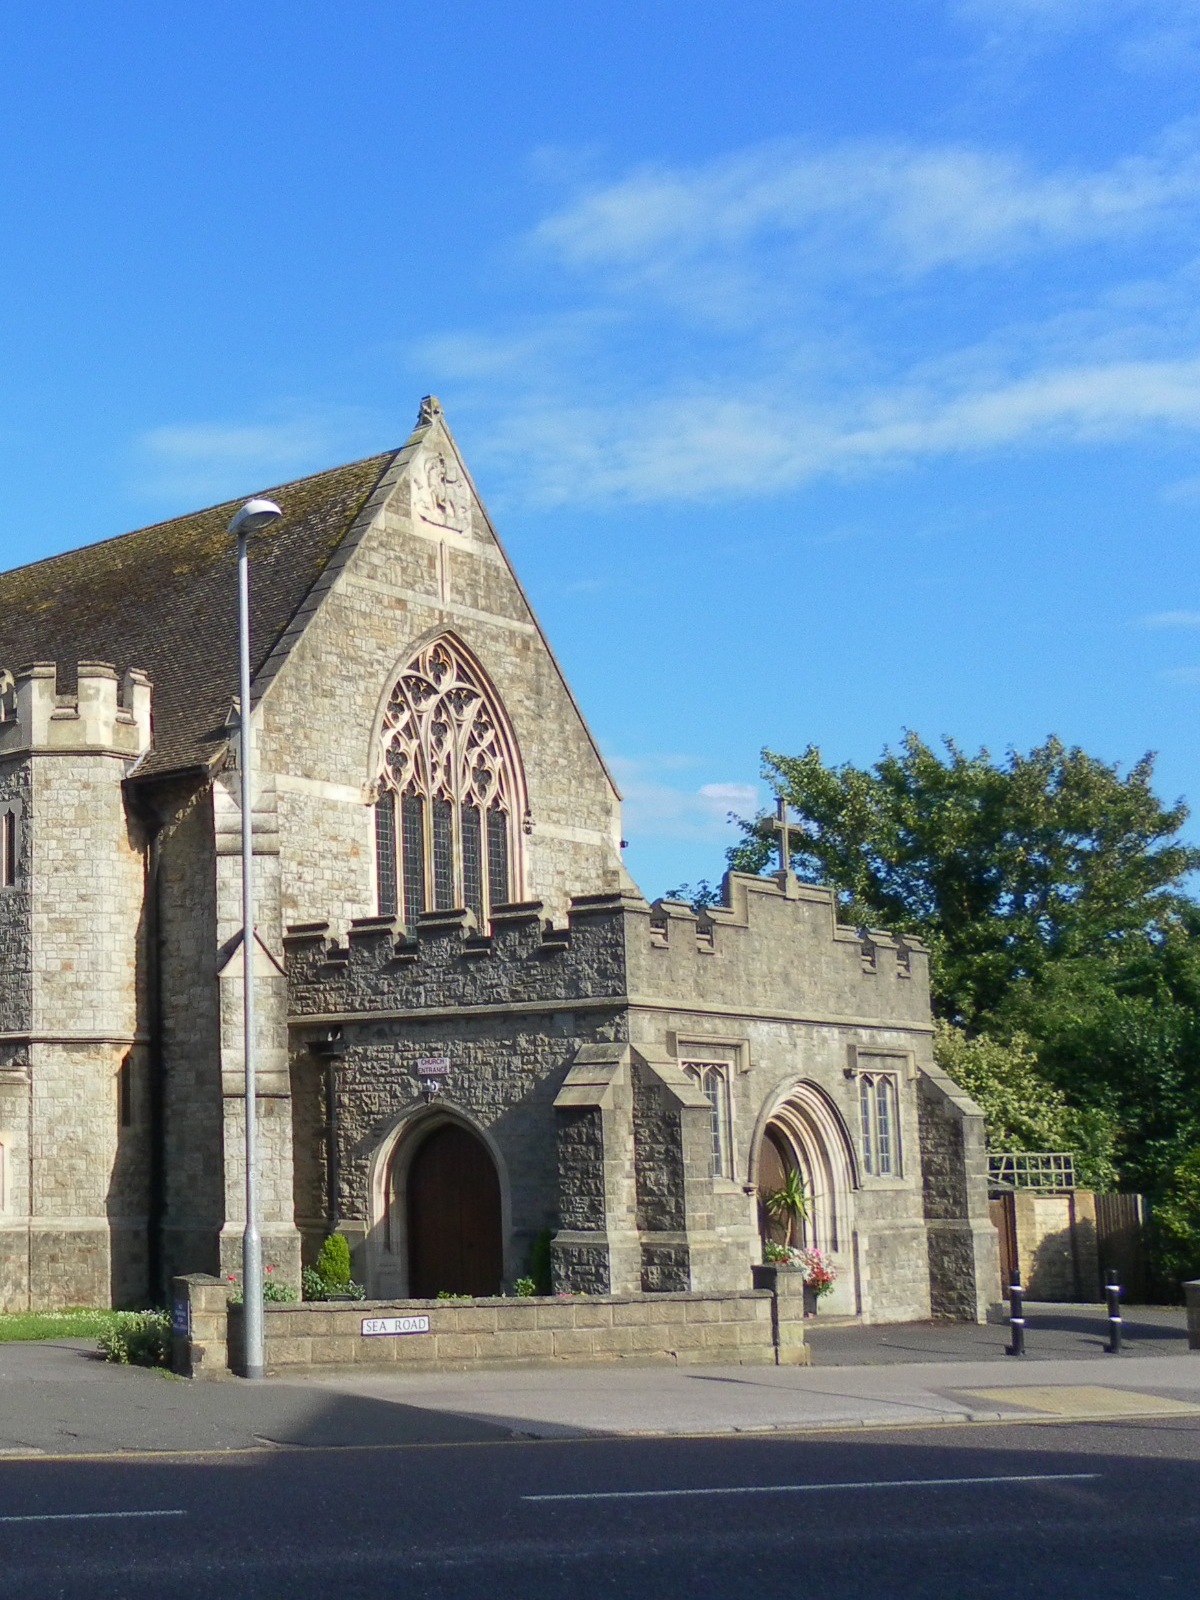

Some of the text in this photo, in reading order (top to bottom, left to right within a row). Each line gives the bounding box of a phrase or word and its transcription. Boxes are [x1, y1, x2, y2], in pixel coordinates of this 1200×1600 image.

[421, 1058, 445, 1066] CHURCH
[418, 1066, 448, 1074] ENTRANCE
[366, 1318, 426, 1332] SEA ROAD
